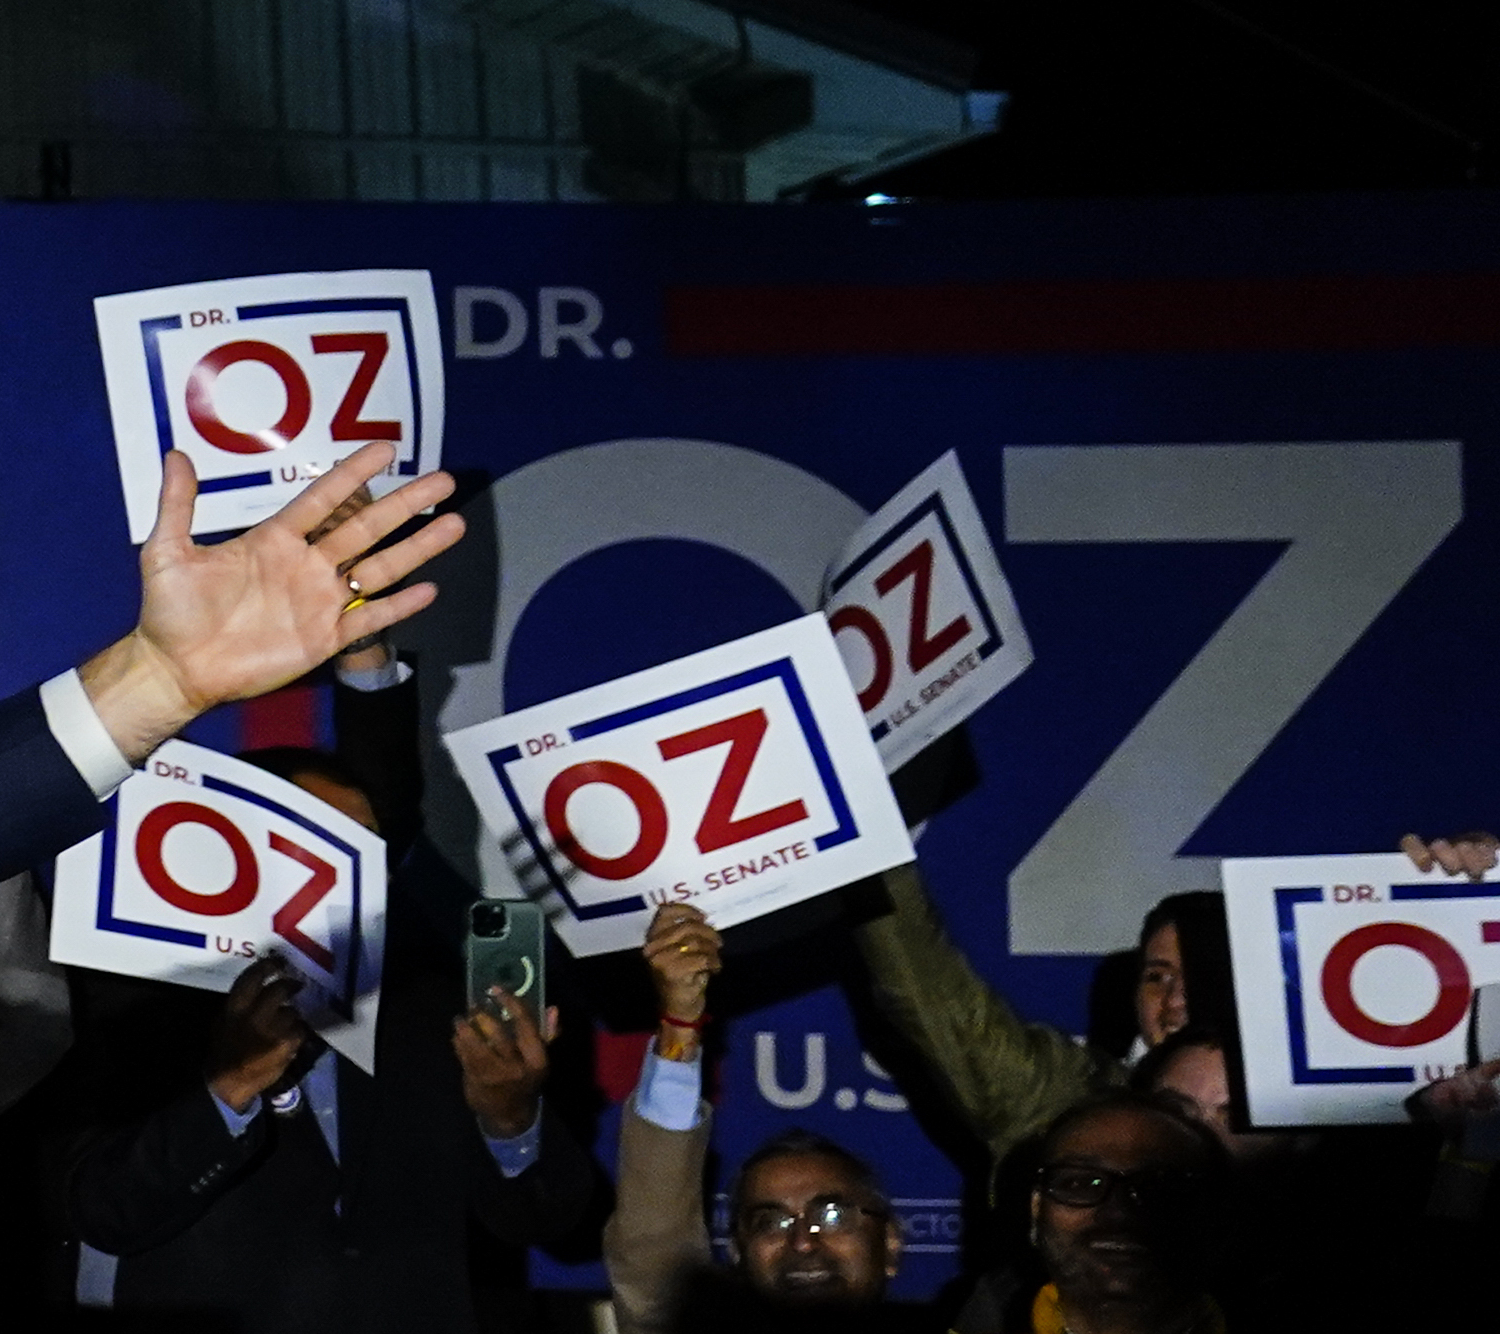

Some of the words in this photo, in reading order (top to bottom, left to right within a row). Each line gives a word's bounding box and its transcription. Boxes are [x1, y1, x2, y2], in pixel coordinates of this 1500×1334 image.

[190, 308, 231, 329] DR.
[453, 283, 634, 360] DR.
[185, 332, 402, 455] OZ
[154, 761, 195, 786] DR.
[526, 731, 567, 757] DR.
[544, 708, 810, 881] OZ
[135, 801, 338, 975] OZ
[704, 840, 811, 892] SENATE
[1333, 884, 1381, 904] DR.
[1321, 921, 1500, 1048] O
